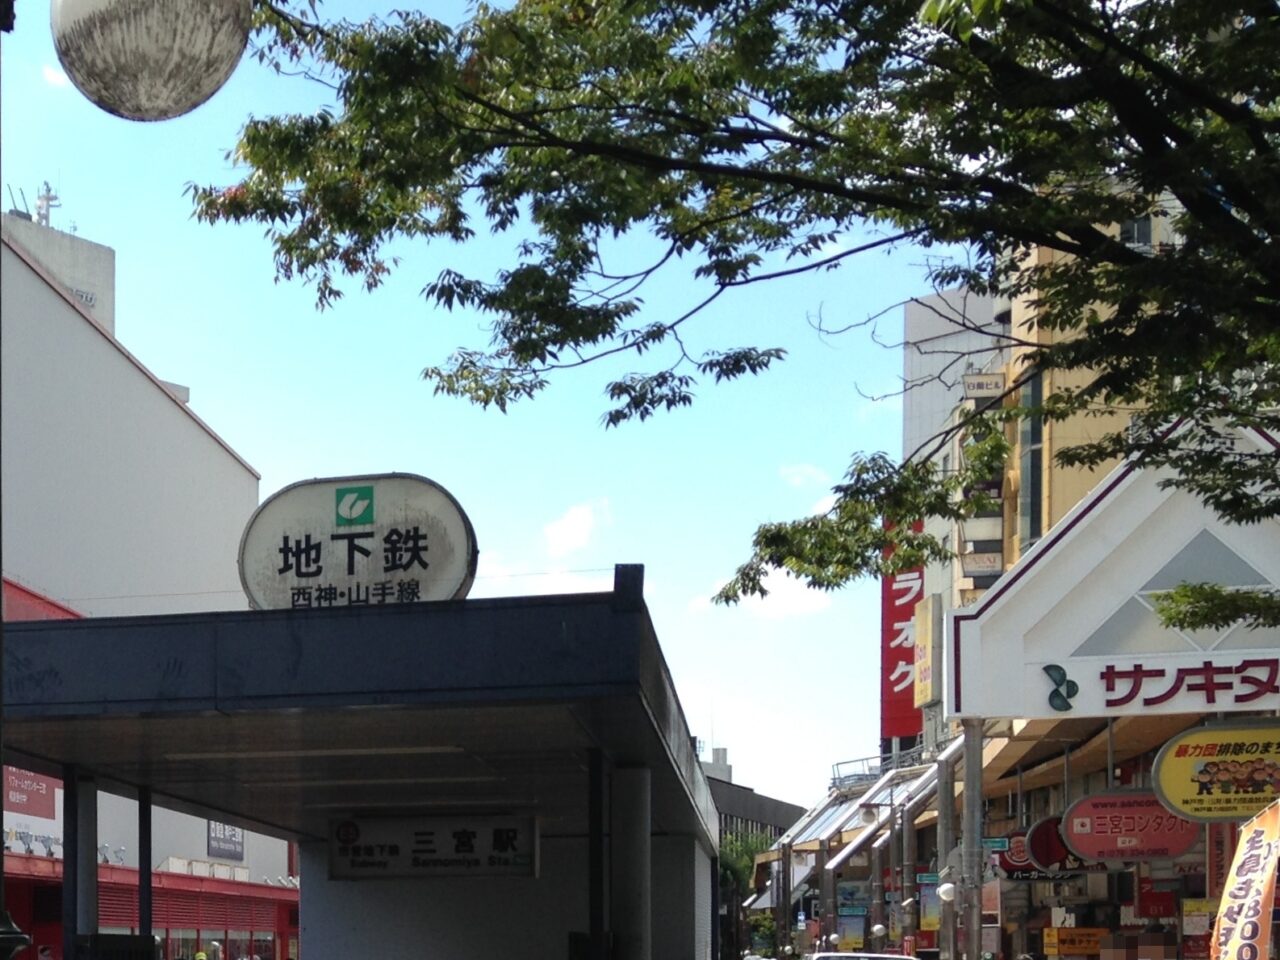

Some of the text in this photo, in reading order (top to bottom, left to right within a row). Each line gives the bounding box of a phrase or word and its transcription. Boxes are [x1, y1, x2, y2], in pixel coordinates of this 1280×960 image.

[278, 526, 429, 578] 地下鉄
[290, 578, 421, 608] 西神・山手線
[1095, 814, 1190, 835] 三宮コンタクト
[412, 828, 518, 854] 三宮駅
[350, 858, 389, 870] Subway
[411, 856, 481, 869] Sannomiya
